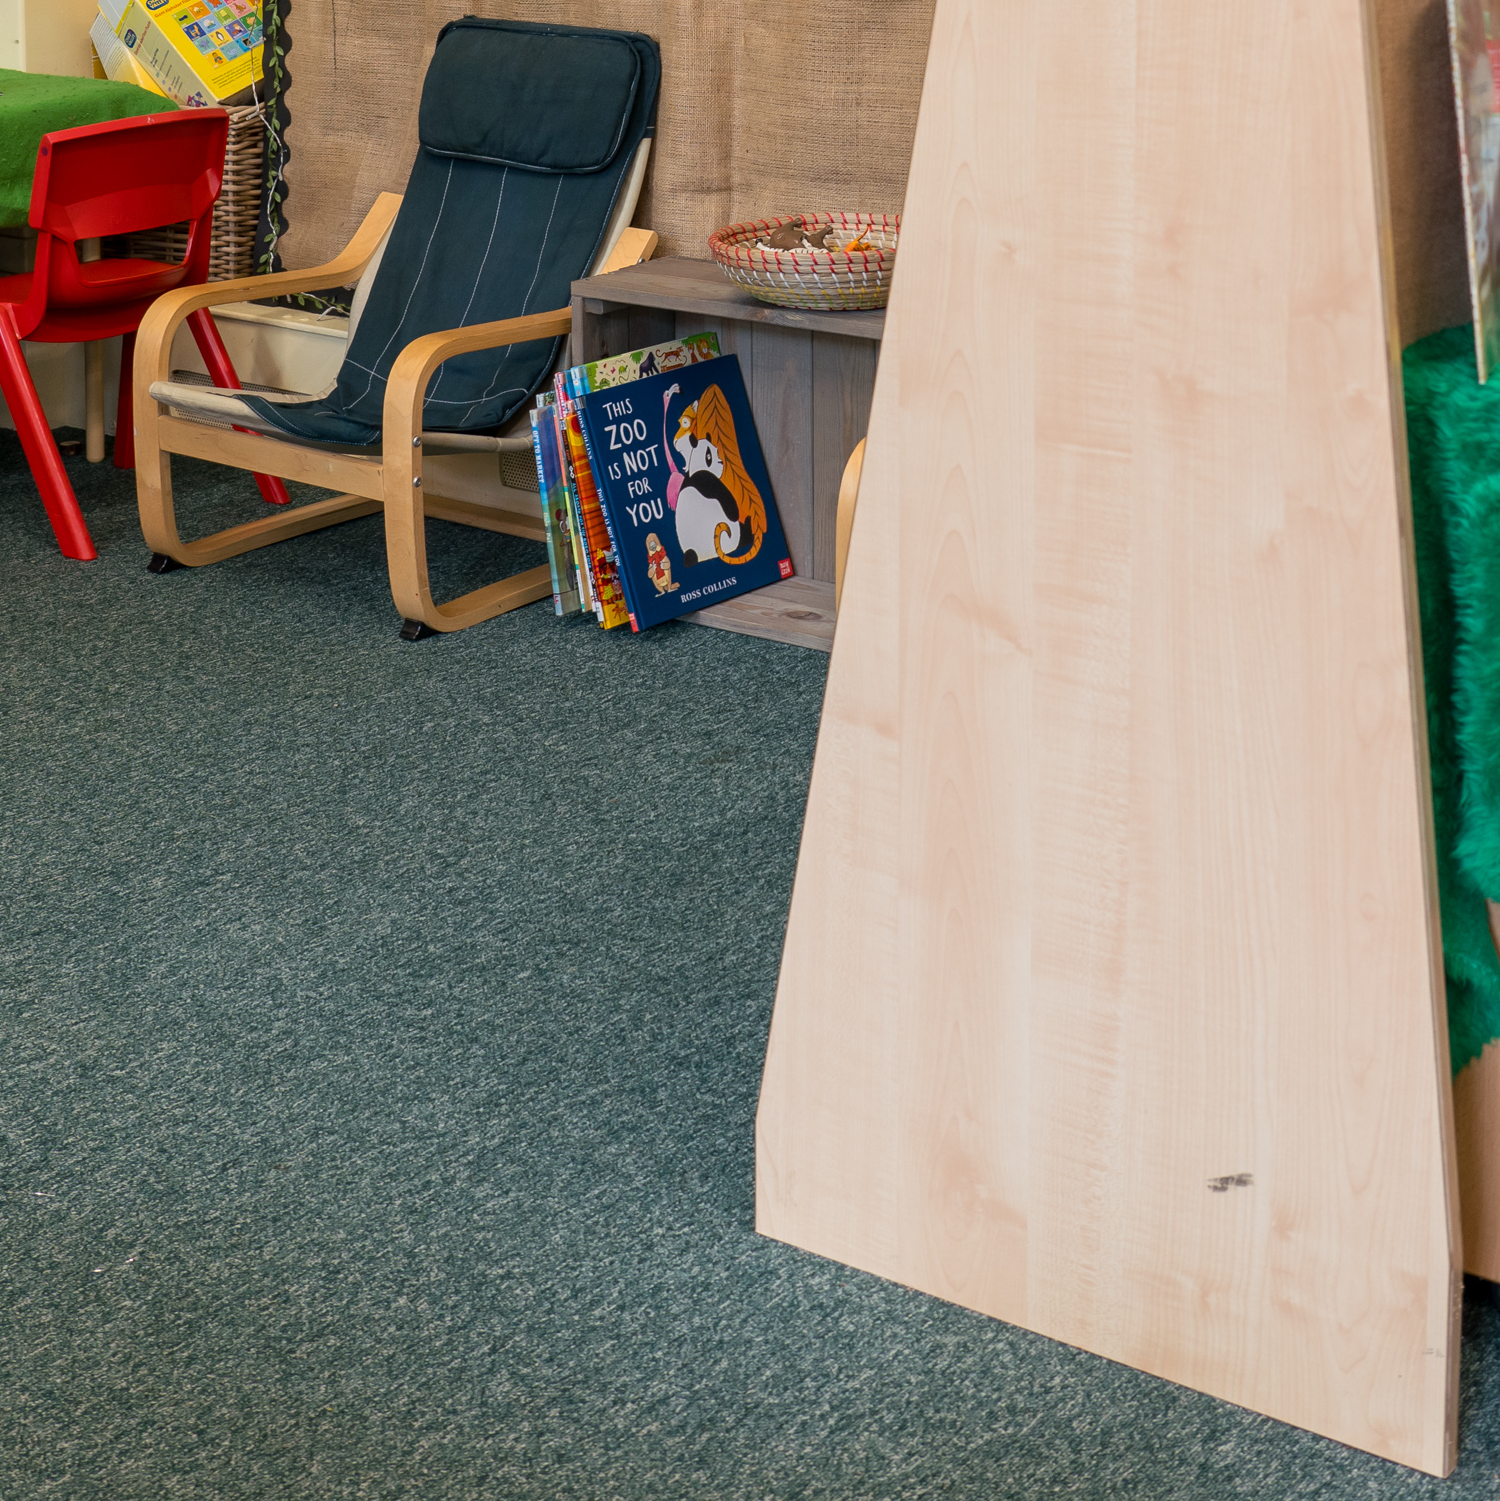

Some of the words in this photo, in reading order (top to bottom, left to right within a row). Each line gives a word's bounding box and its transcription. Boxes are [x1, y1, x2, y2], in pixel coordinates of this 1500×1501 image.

[602, 398, 633, 421] THIS
[604, 419, 647, 450] ZOO
[608, 464, 622, 481] IS
[623, 444, 659, 477] NOT
[627, 477, 653, 499] FOR
[626, 498, 664, 527] YOU
[680, 589, 702, 604] ROSS
[702, 576, 738, 596] COLLINS
